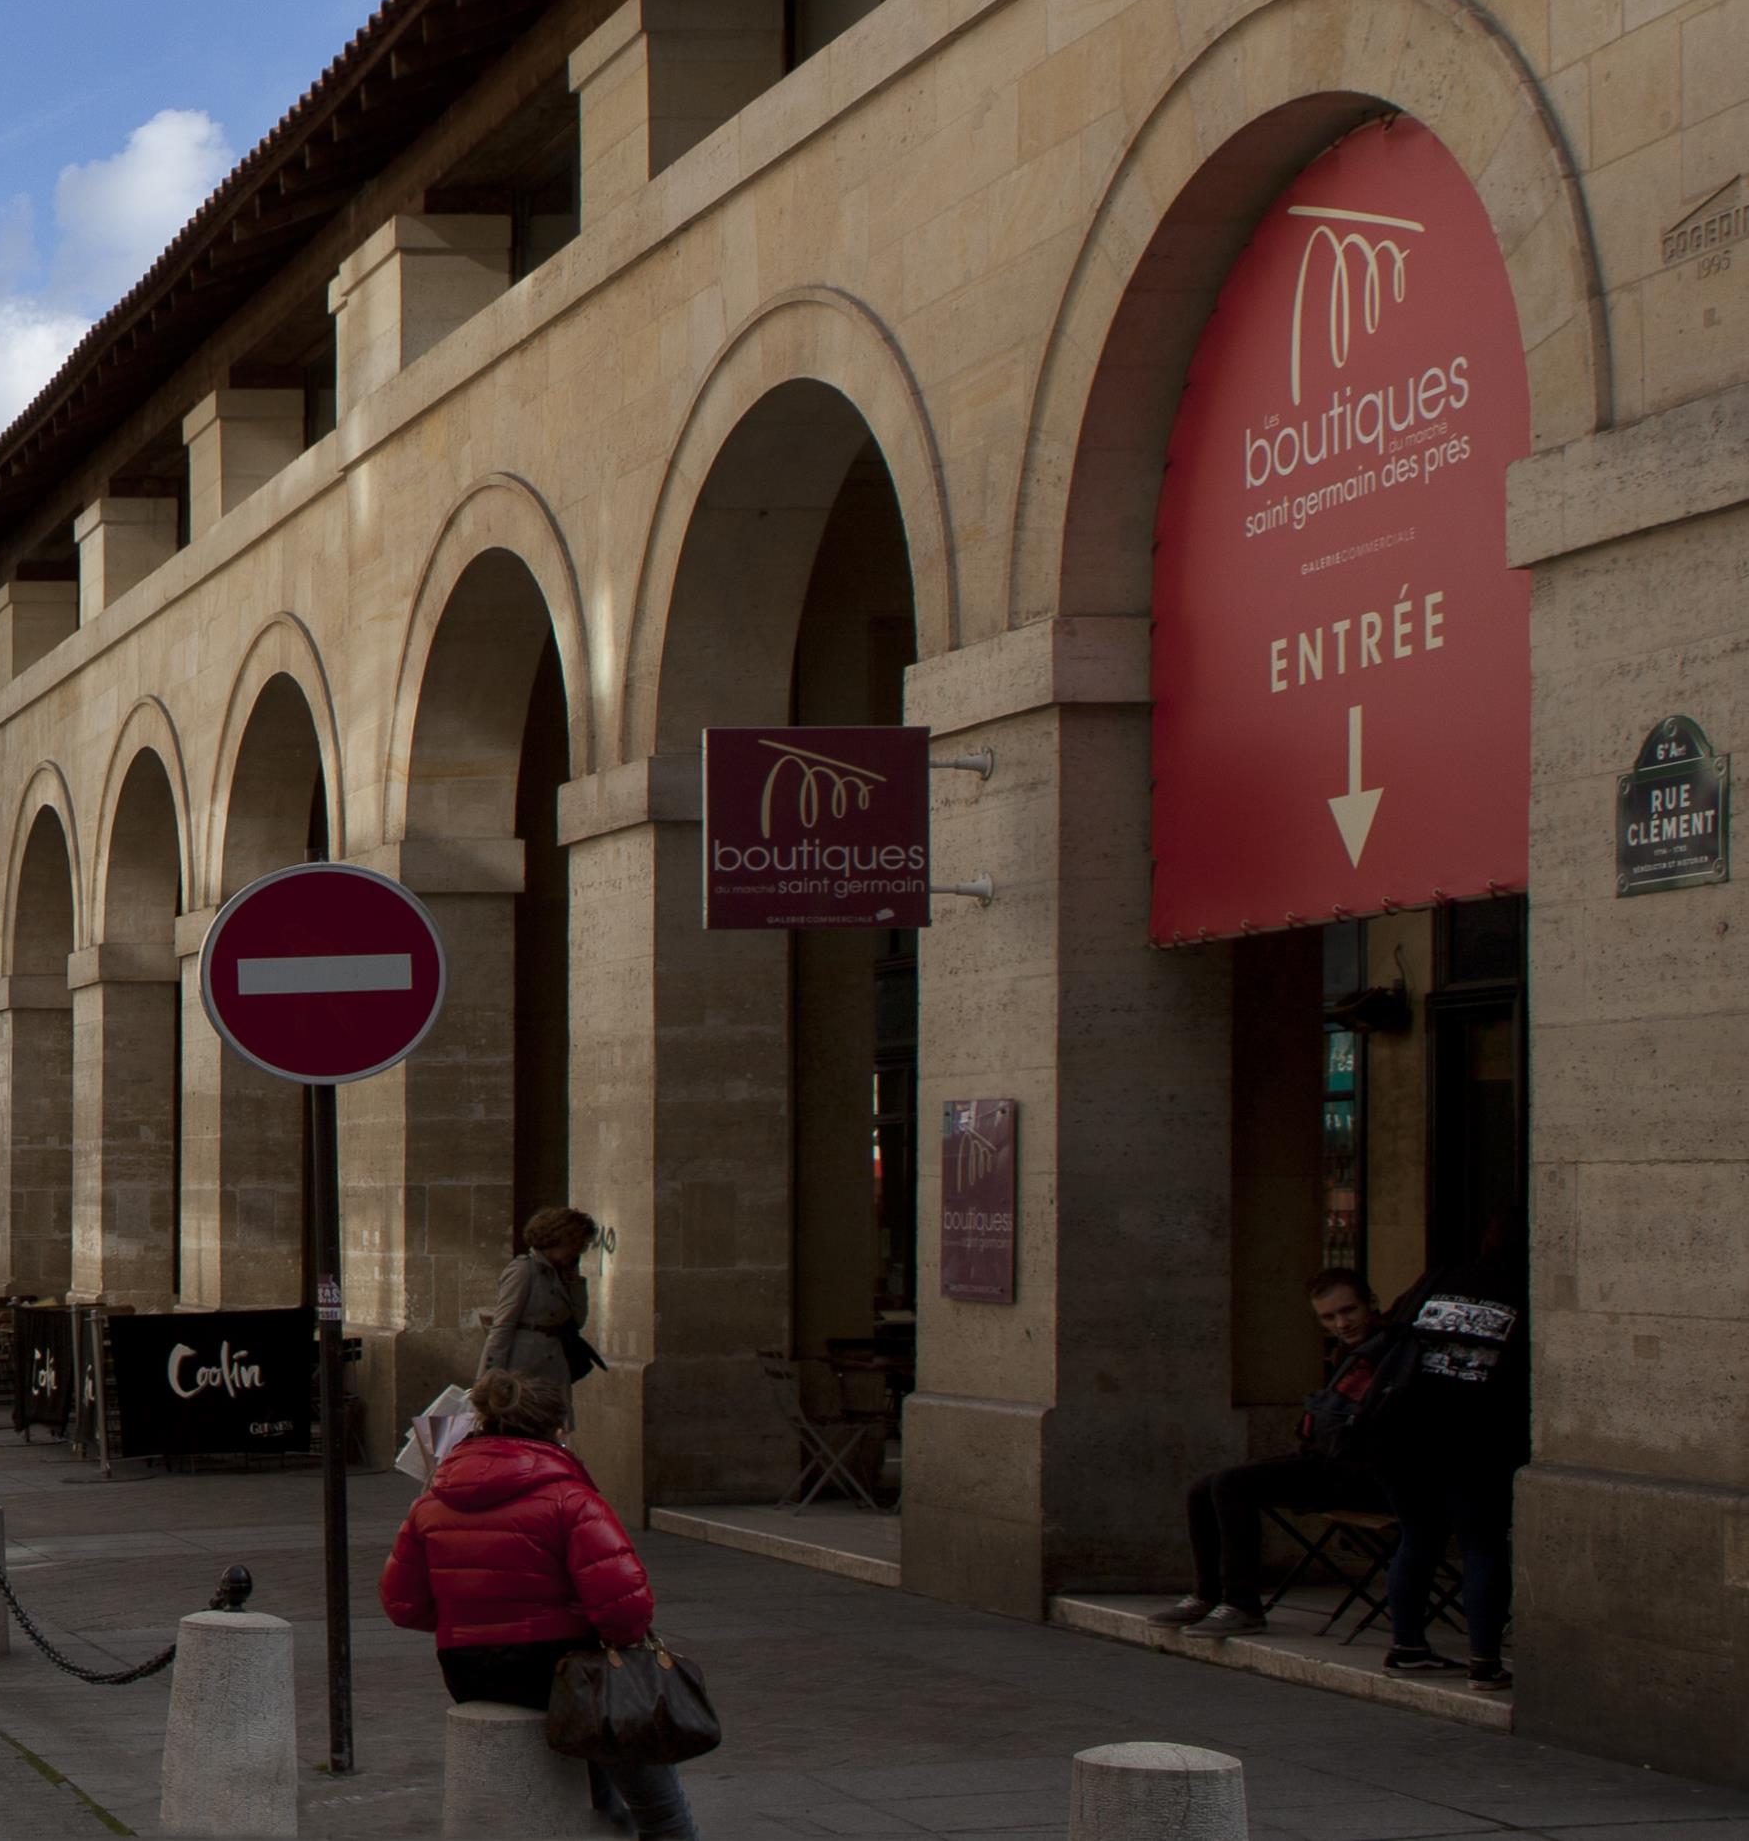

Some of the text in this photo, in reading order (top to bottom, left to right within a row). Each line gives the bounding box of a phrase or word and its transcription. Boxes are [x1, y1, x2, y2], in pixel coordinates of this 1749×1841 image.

[1697, 249, 1731, 280] 1995
[1246, 356, 1469, 490] boutiques
[1263, 414, 1280, 431] Les
[1389, 418, 1448, 454] du marché
[1245, 433, 1471, 539] saint germain des prés
[1271, 583, 1444, 693] ENTRÉE
[1651, 783, 1692, 813] RUE
[1627, 810, 1716, 846] CLÉMENT
[714, 838, 925, 878] boutiques
[714, 884, 731, 895] du
[778, 877, 829, 895] saint
[833, 877, 925, 899] germain
[944, 1206, 1011, 1237] boutiques
